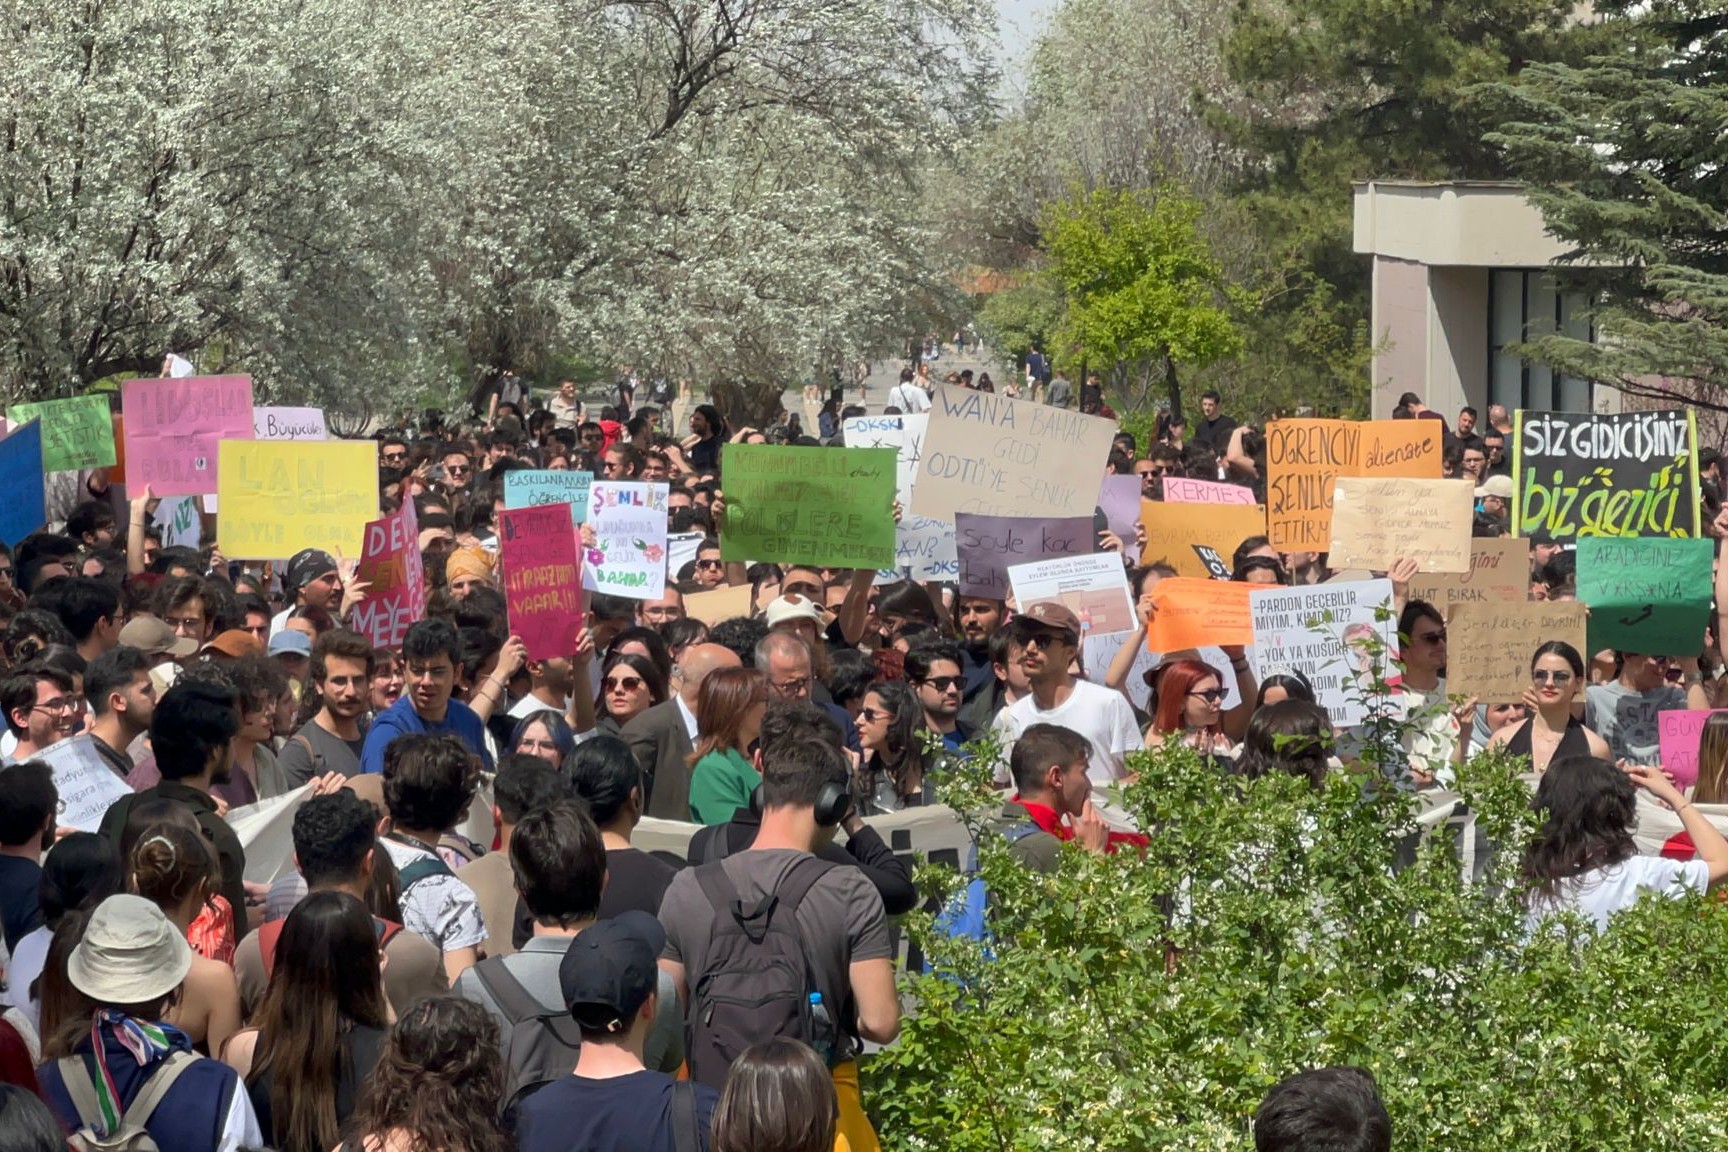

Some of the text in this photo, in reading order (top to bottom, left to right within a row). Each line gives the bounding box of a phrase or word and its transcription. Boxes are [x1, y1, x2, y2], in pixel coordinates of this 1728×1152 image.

[1028, 408, 1090, 446] BAHAR
[1523, 413, 1570, 457] SİZ
[1270, 424, 1433, 469] ÖĞRENCİYİ alienate
[1165, 479, 1250, 505] KERMES
[1270, 469, 1337, 516] ŞENLİĞ
[1522, 466, 1577, 540] biz
[1272, 516, 1330, 545] ETTİRM
[1306, 590, 1357, 609] GEÇEBİLİR
[1410, 588, 1439, 602] AHAT
[1447, 587, 1489, 602] BIRAK
[1290, 645, 1303, 661] YA
